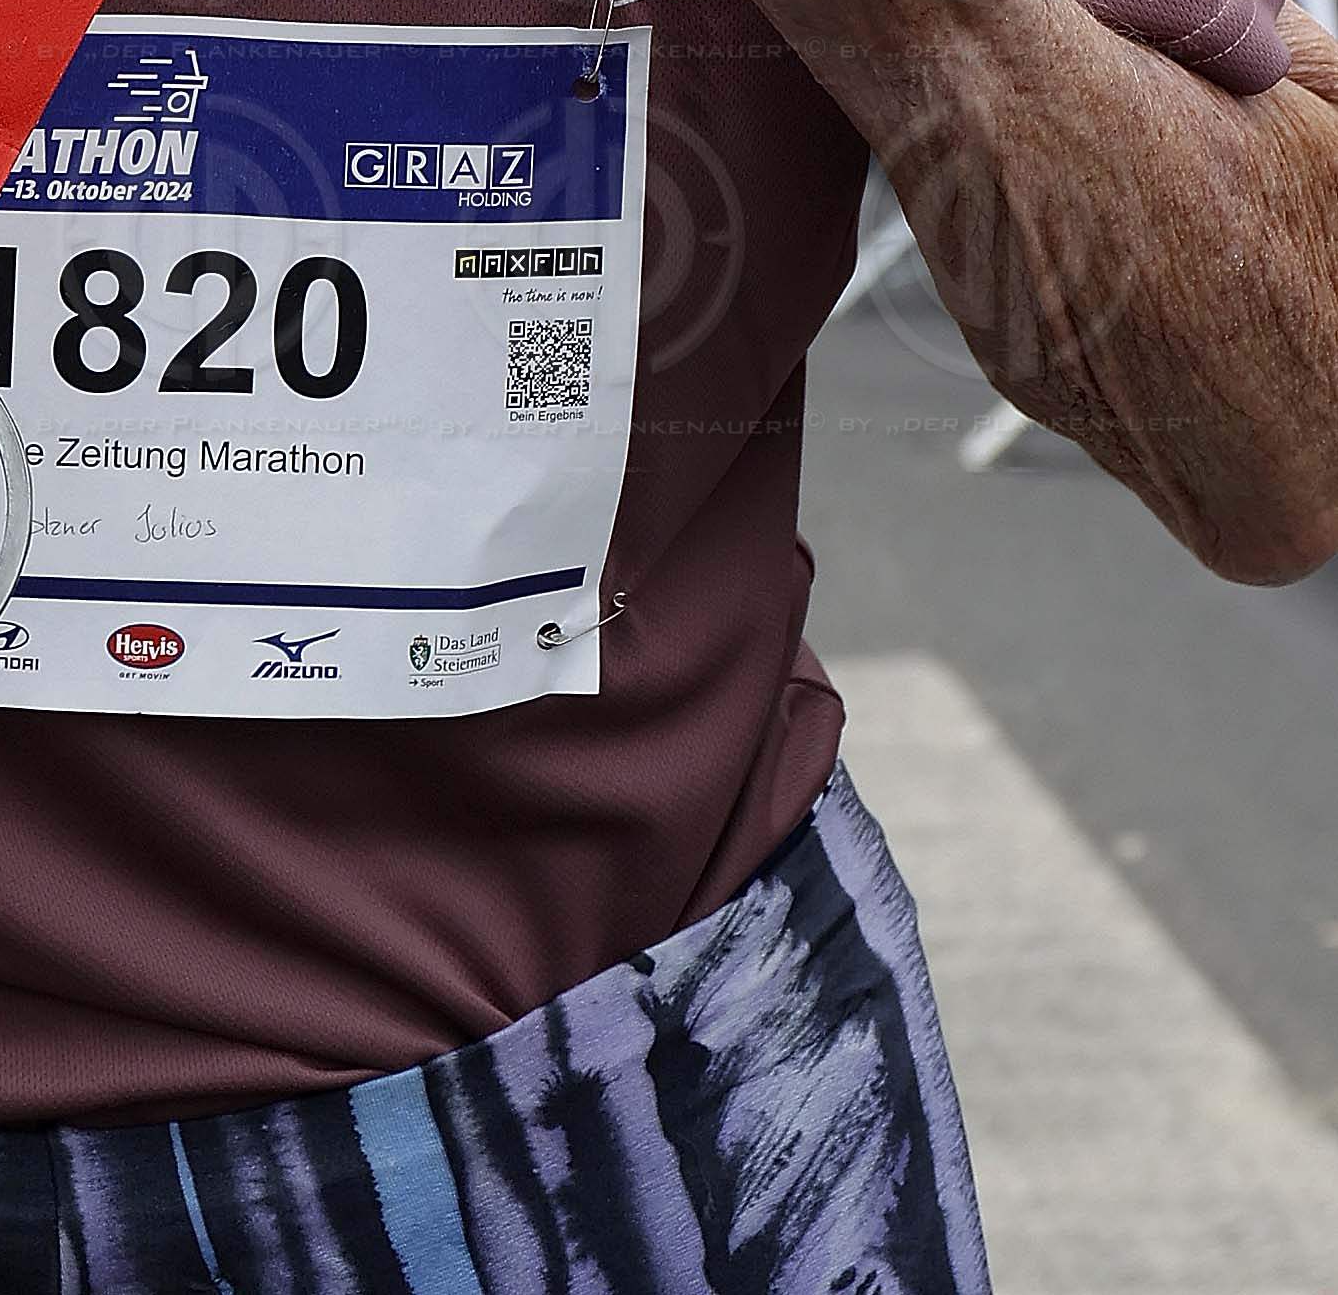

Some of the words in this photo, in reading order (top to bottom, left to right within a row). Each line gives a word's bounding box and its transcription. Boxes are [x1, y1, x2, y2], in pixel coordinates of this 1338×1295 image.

[12, 128, 199, 176] ATHON
[348, 146, 530, 186] GRAZ
[47, 180, 137, 202] Oktober
[140, 181, 193, 202] 2024
[458, 191, 532, 208] HOLDING
[502, 287, 523, 304] the
[525, 289, 553, 304] time
[557, 287, 567, 302] is
[510, 410, 535, 423] Dein
[538, 410, 584, 423] Ergebnis
[56, 437, 187, 478] Zeitung
[200, 440, 365, 476] Marathon
[115, 633, 179, 660] Hervis
[440, 635, 466, 651] Das
[470, 626, 499, 648] Land
[123, 654, 149, 662] SPORTS
[433, 650, 498, 673] Steiermark
[119, 671, 136, 679] GET
[250, 661, 339, 679] MIZUNO
[420, 677, 444, 689] Sport
